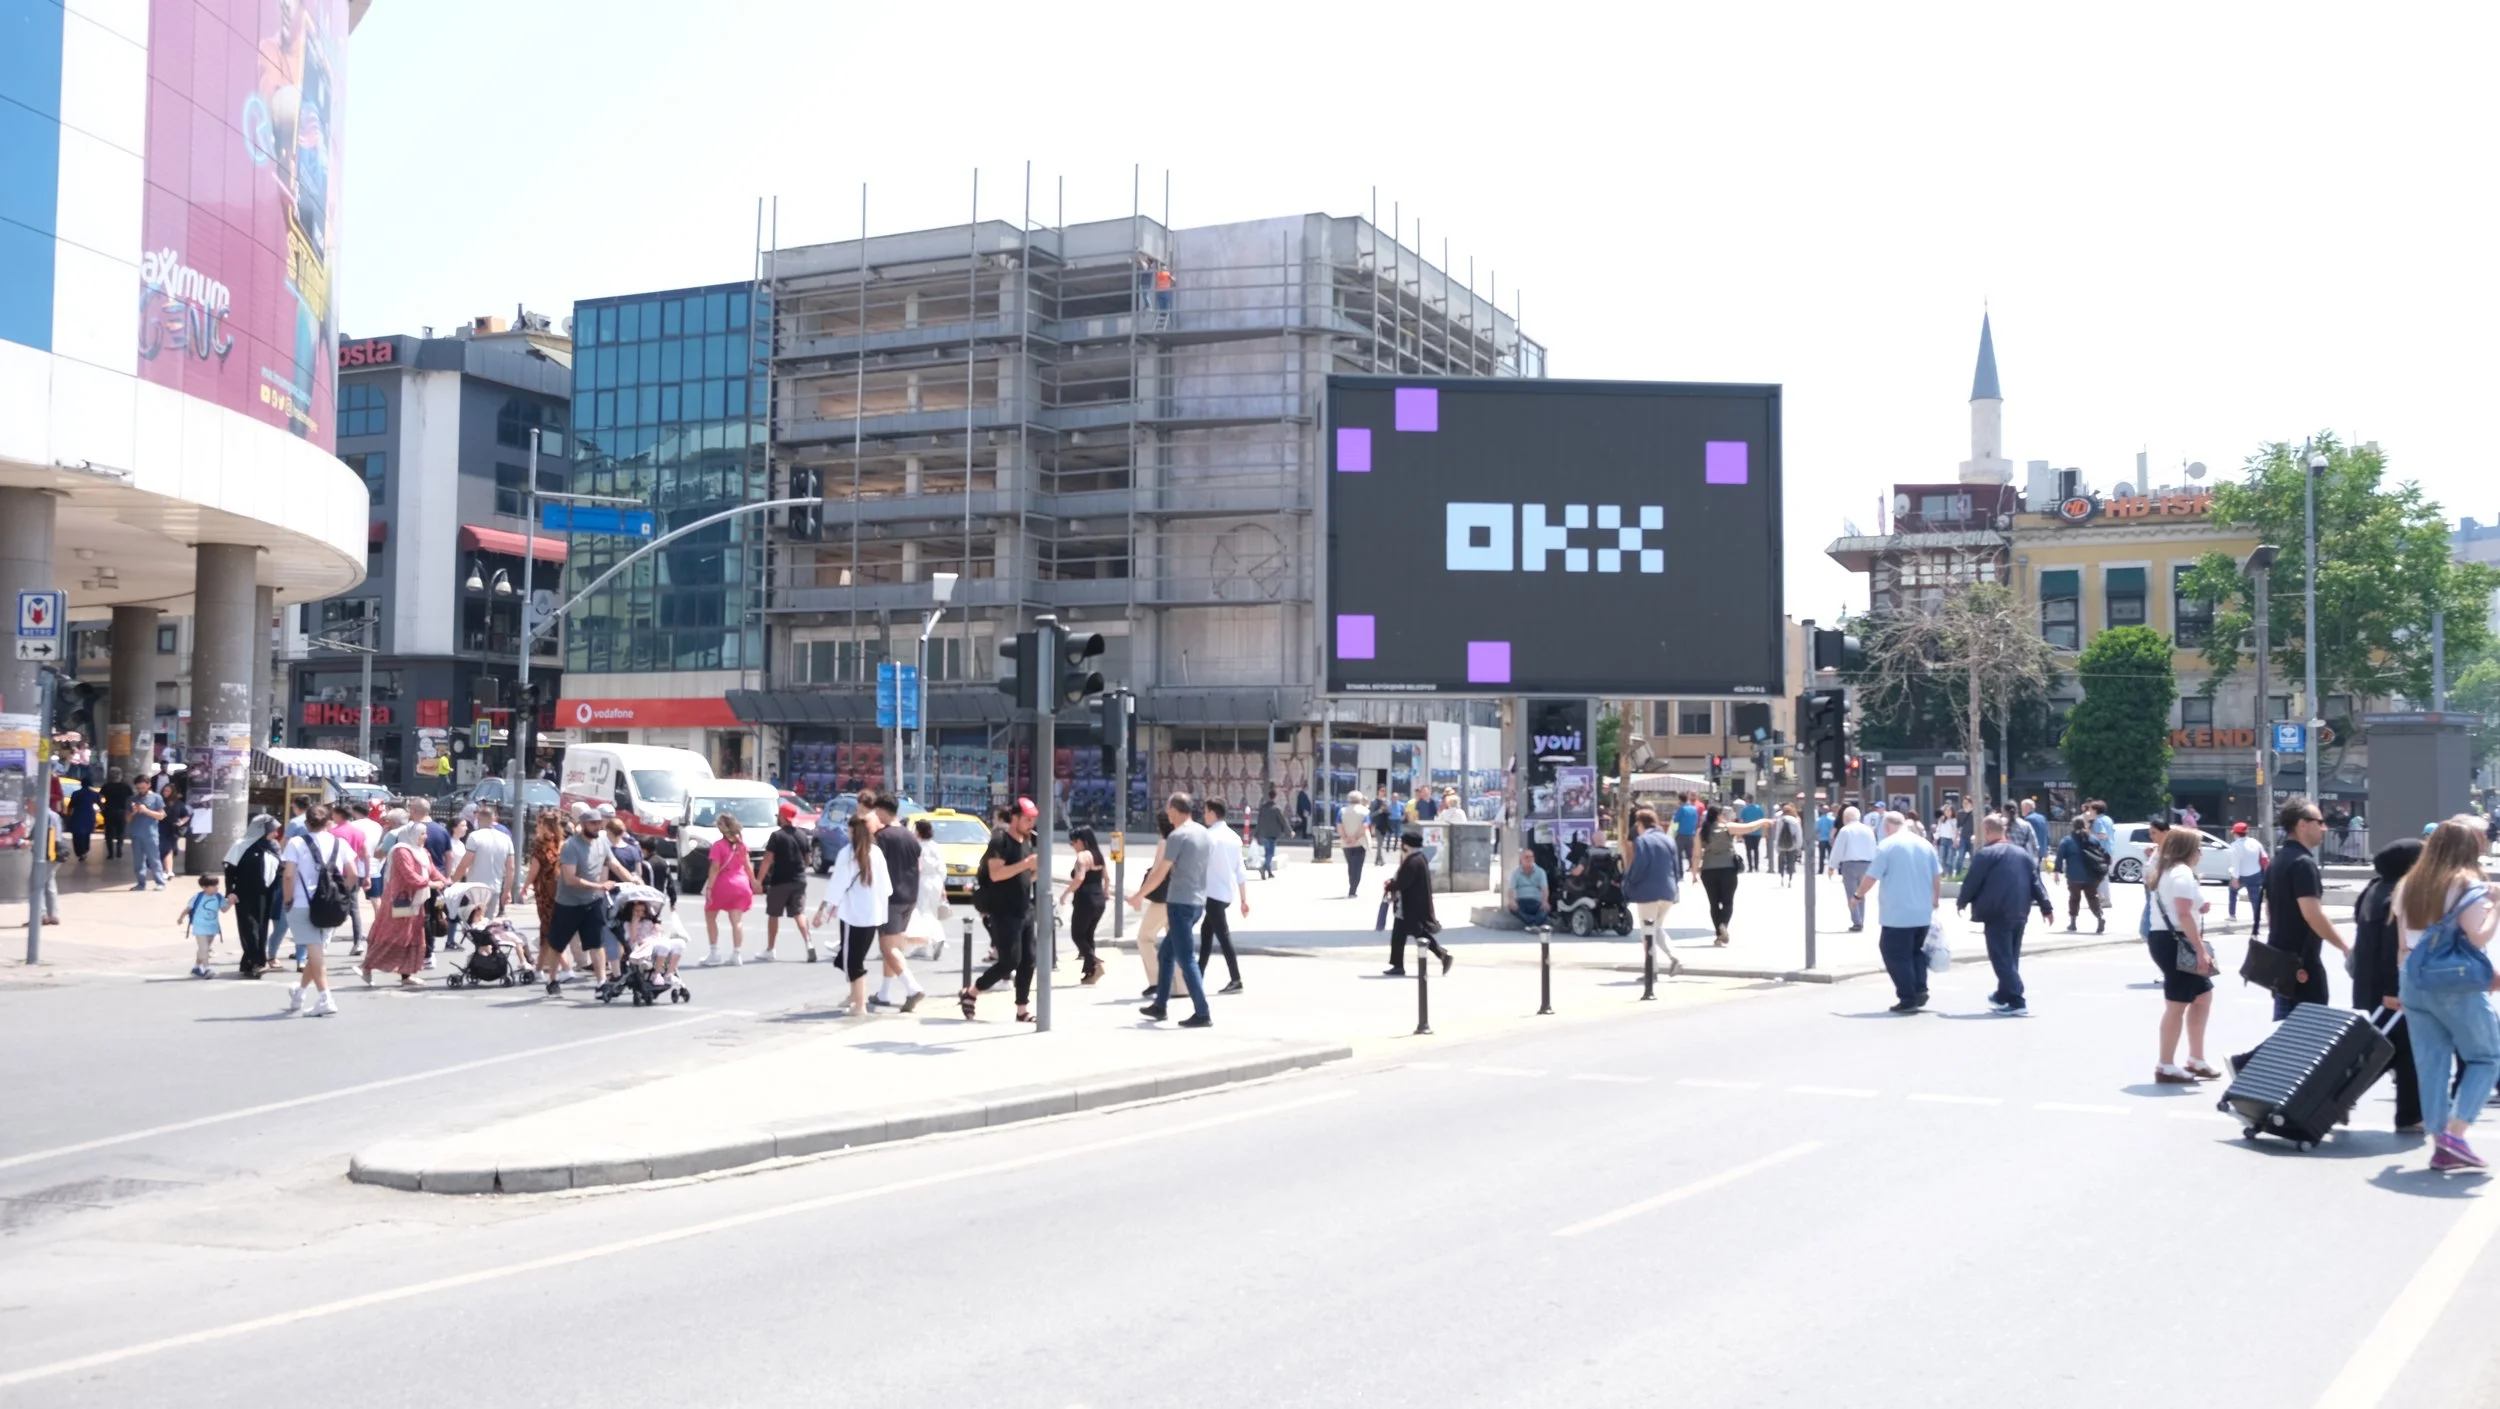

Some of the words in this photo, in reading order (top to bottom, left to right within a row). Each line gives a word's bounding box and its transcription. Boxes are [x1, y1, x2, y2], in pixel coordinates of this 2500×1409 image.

[142, 246, 230, 309] aximum
[338, 338, 392, 367] osta
[2105, 496, 2150, 518] HD
[2160, 493, 2214, 517] ISK
[1447, 502, 1664, 573] OKX
[324, 703, 390, 725] Hosta
[594, 708, 634, 719] vodafone
[1534, 730, 1582, 754] yovi
[2164, 727, 2256, 749] KEND
